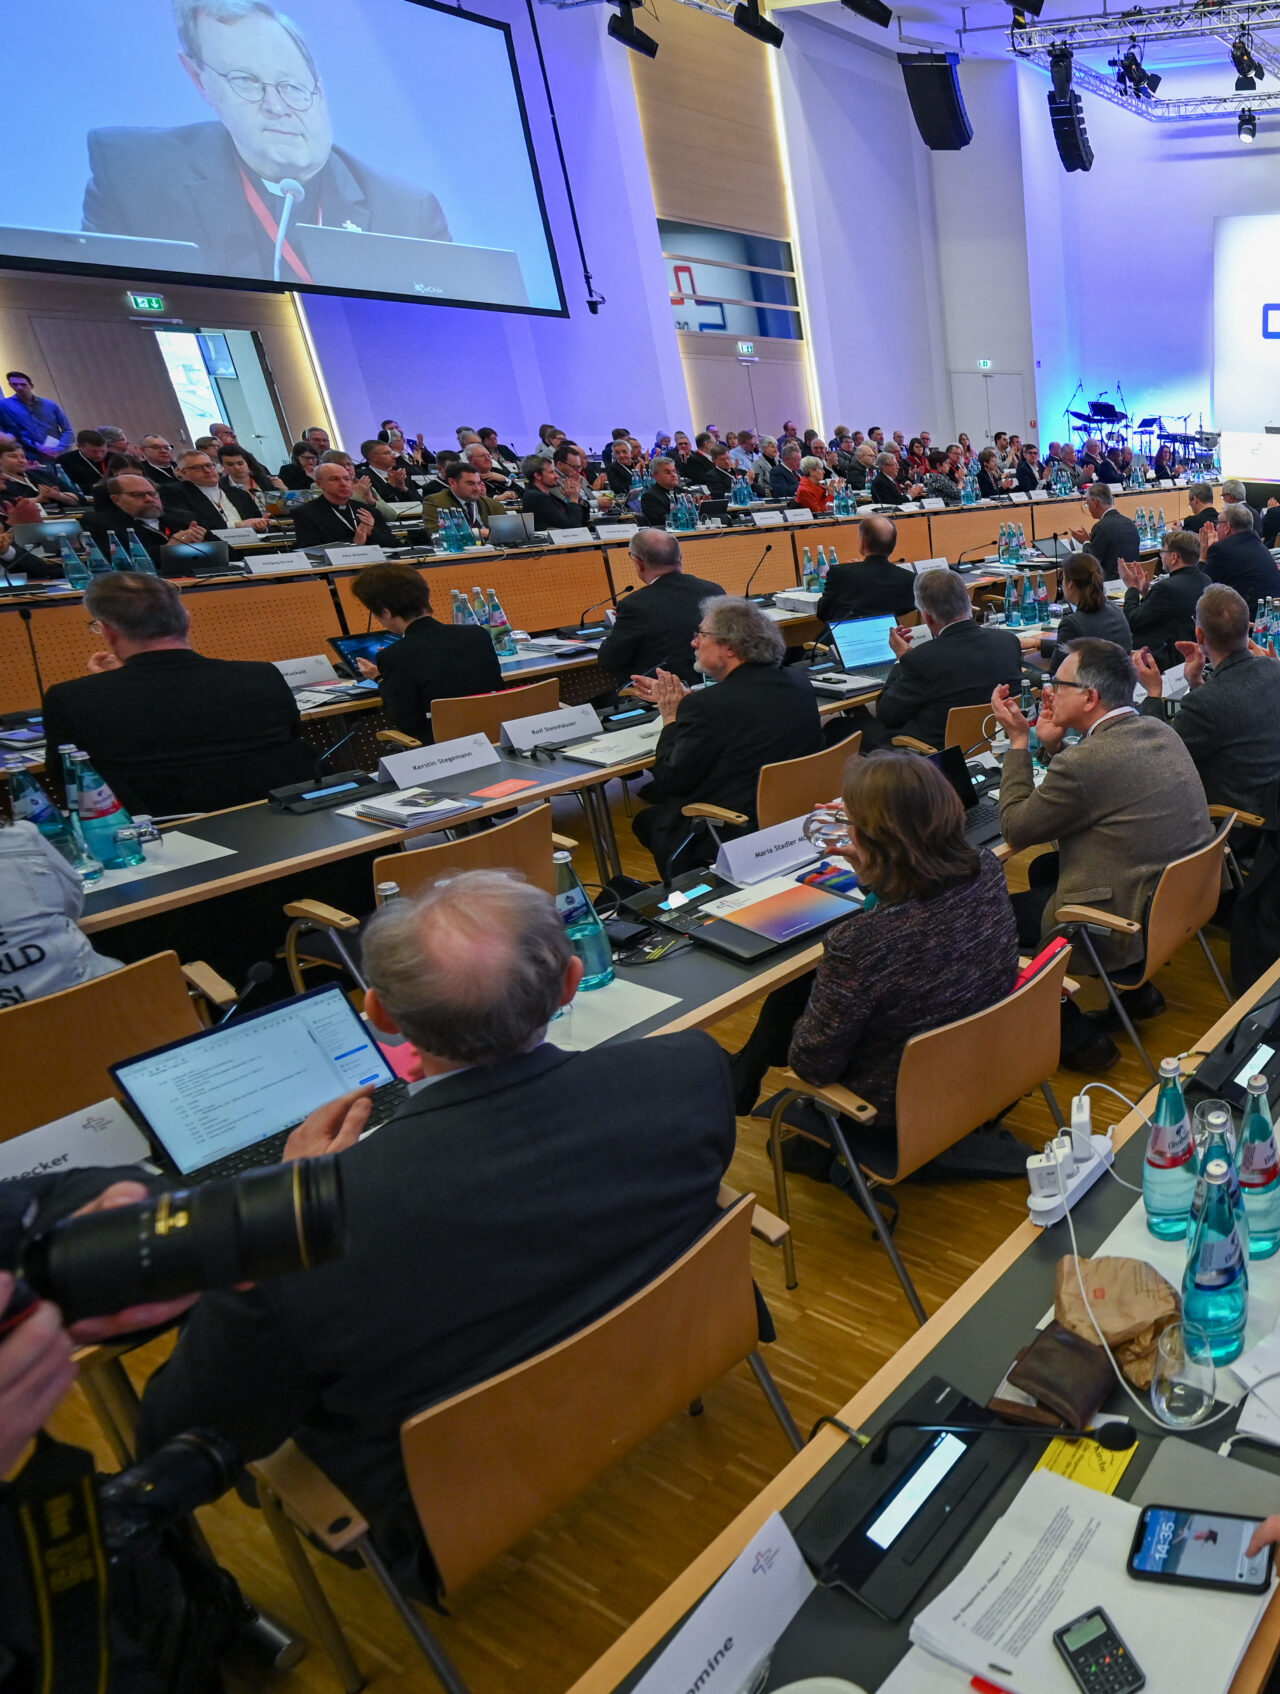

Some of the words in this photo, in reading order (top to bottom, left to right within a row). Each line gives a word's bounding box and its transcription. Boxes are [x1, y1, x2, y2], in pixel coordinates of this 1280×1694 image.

[412, 761, 437, 770] Kerstin
[438, 751, 473, 763] Stegemann
[754, 848, 773, 859] Maria
[774, 839, 797, 852] Stadler
[1155, 1521, 1175, 1561] 14:35
